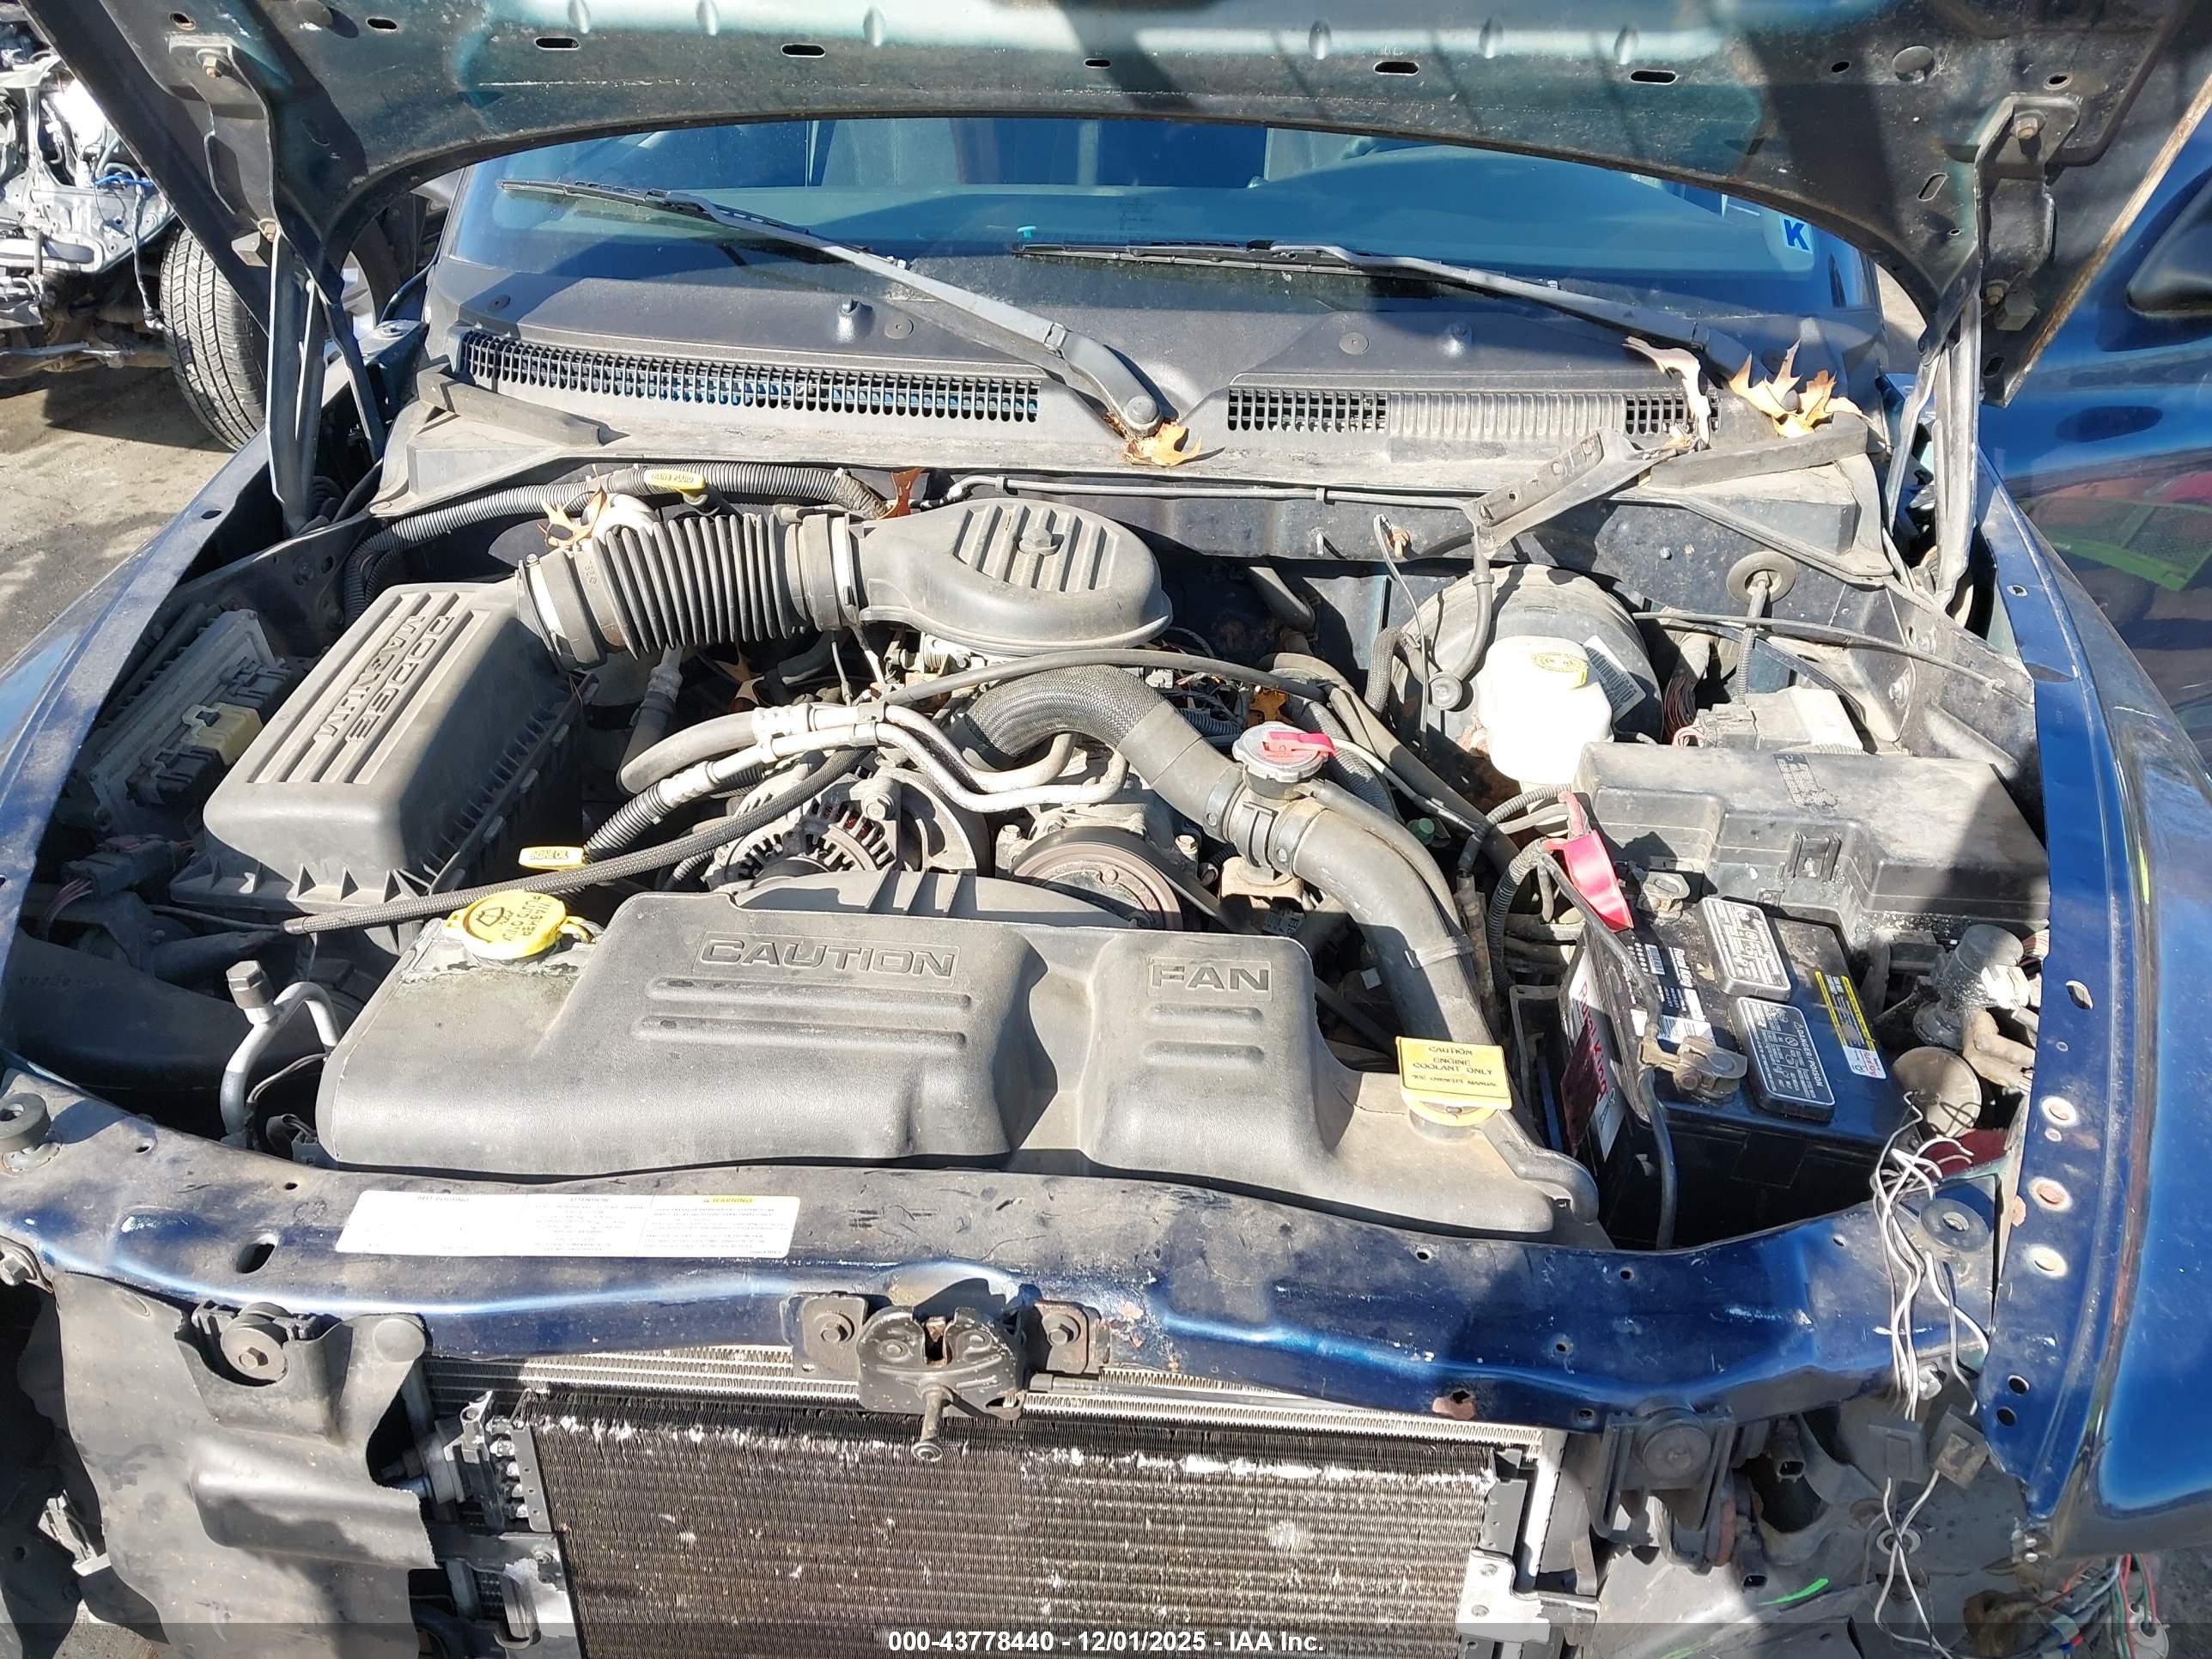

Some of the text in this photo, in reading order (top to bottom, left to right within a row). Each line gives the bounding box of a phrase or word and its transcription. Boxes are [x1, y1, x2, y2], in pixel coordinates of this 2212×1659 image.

[1784, 218, 1809, 250] K
[313, 615, 426, 742] MAGNUM
[345, 616, 455, 743] DODGE
[701, 939, 956, 978] CAUTION
[1672, 947, 1691, 969] Rural
[1152, 964, 1269, 992] FAN
[1428, 1046, 1473, 1055] CAUTION
[1433, 1057, 1471, 1066] ENGINE
[1413, 1062, 1493, 1076] COOLANT ONLY
